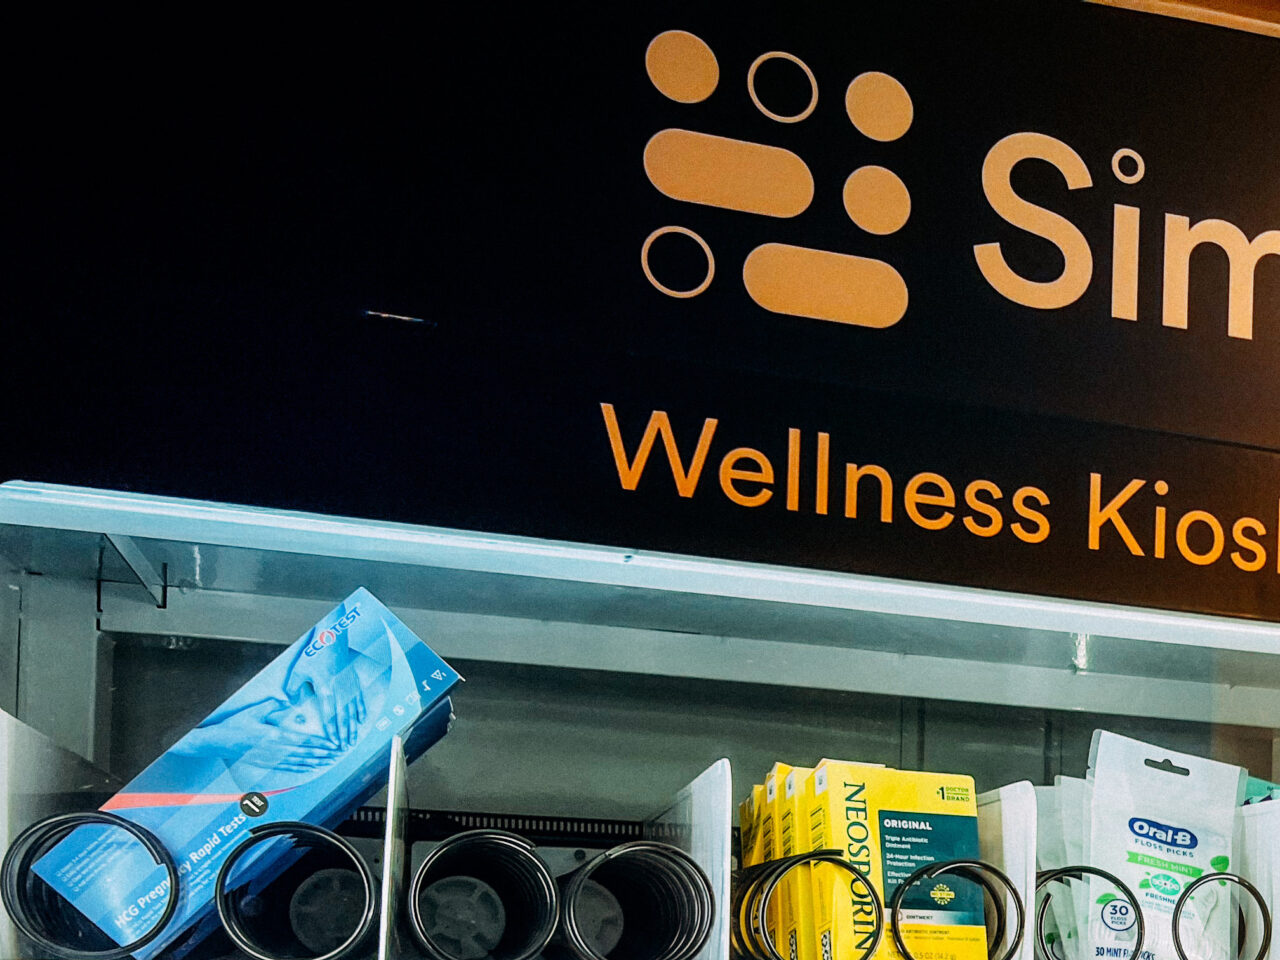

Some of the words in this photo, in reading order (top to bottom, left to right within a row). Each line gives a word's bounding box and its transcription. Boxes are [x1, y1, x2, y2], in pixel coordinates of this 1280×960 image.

[599, 402, 1051, 545] Wellness
[304, 605, 362, 657] ECOTEST
[884, 819, 932, 831] ORIGINAL
[1133, 821, 1191, 845] Oral-B
[1134, 838, 1163, 852] FLOSS
[1166, 848, 1194, 858] PICKS
[114, 904, 139, 928] HCG
[189, 833, 221, 864] Rapid
[218, 813, 247, 838] Tests
[843, 781, 876, 950] NEOSPORIN
[1137, 855, 1168, 868] FRESH
[1170, 863, 1194, 875] MINT
[1109, 904, 1129, 916] 30
[1095, 946, 1105, 957] 30
[1105, 947, 1122, 957] MINT
